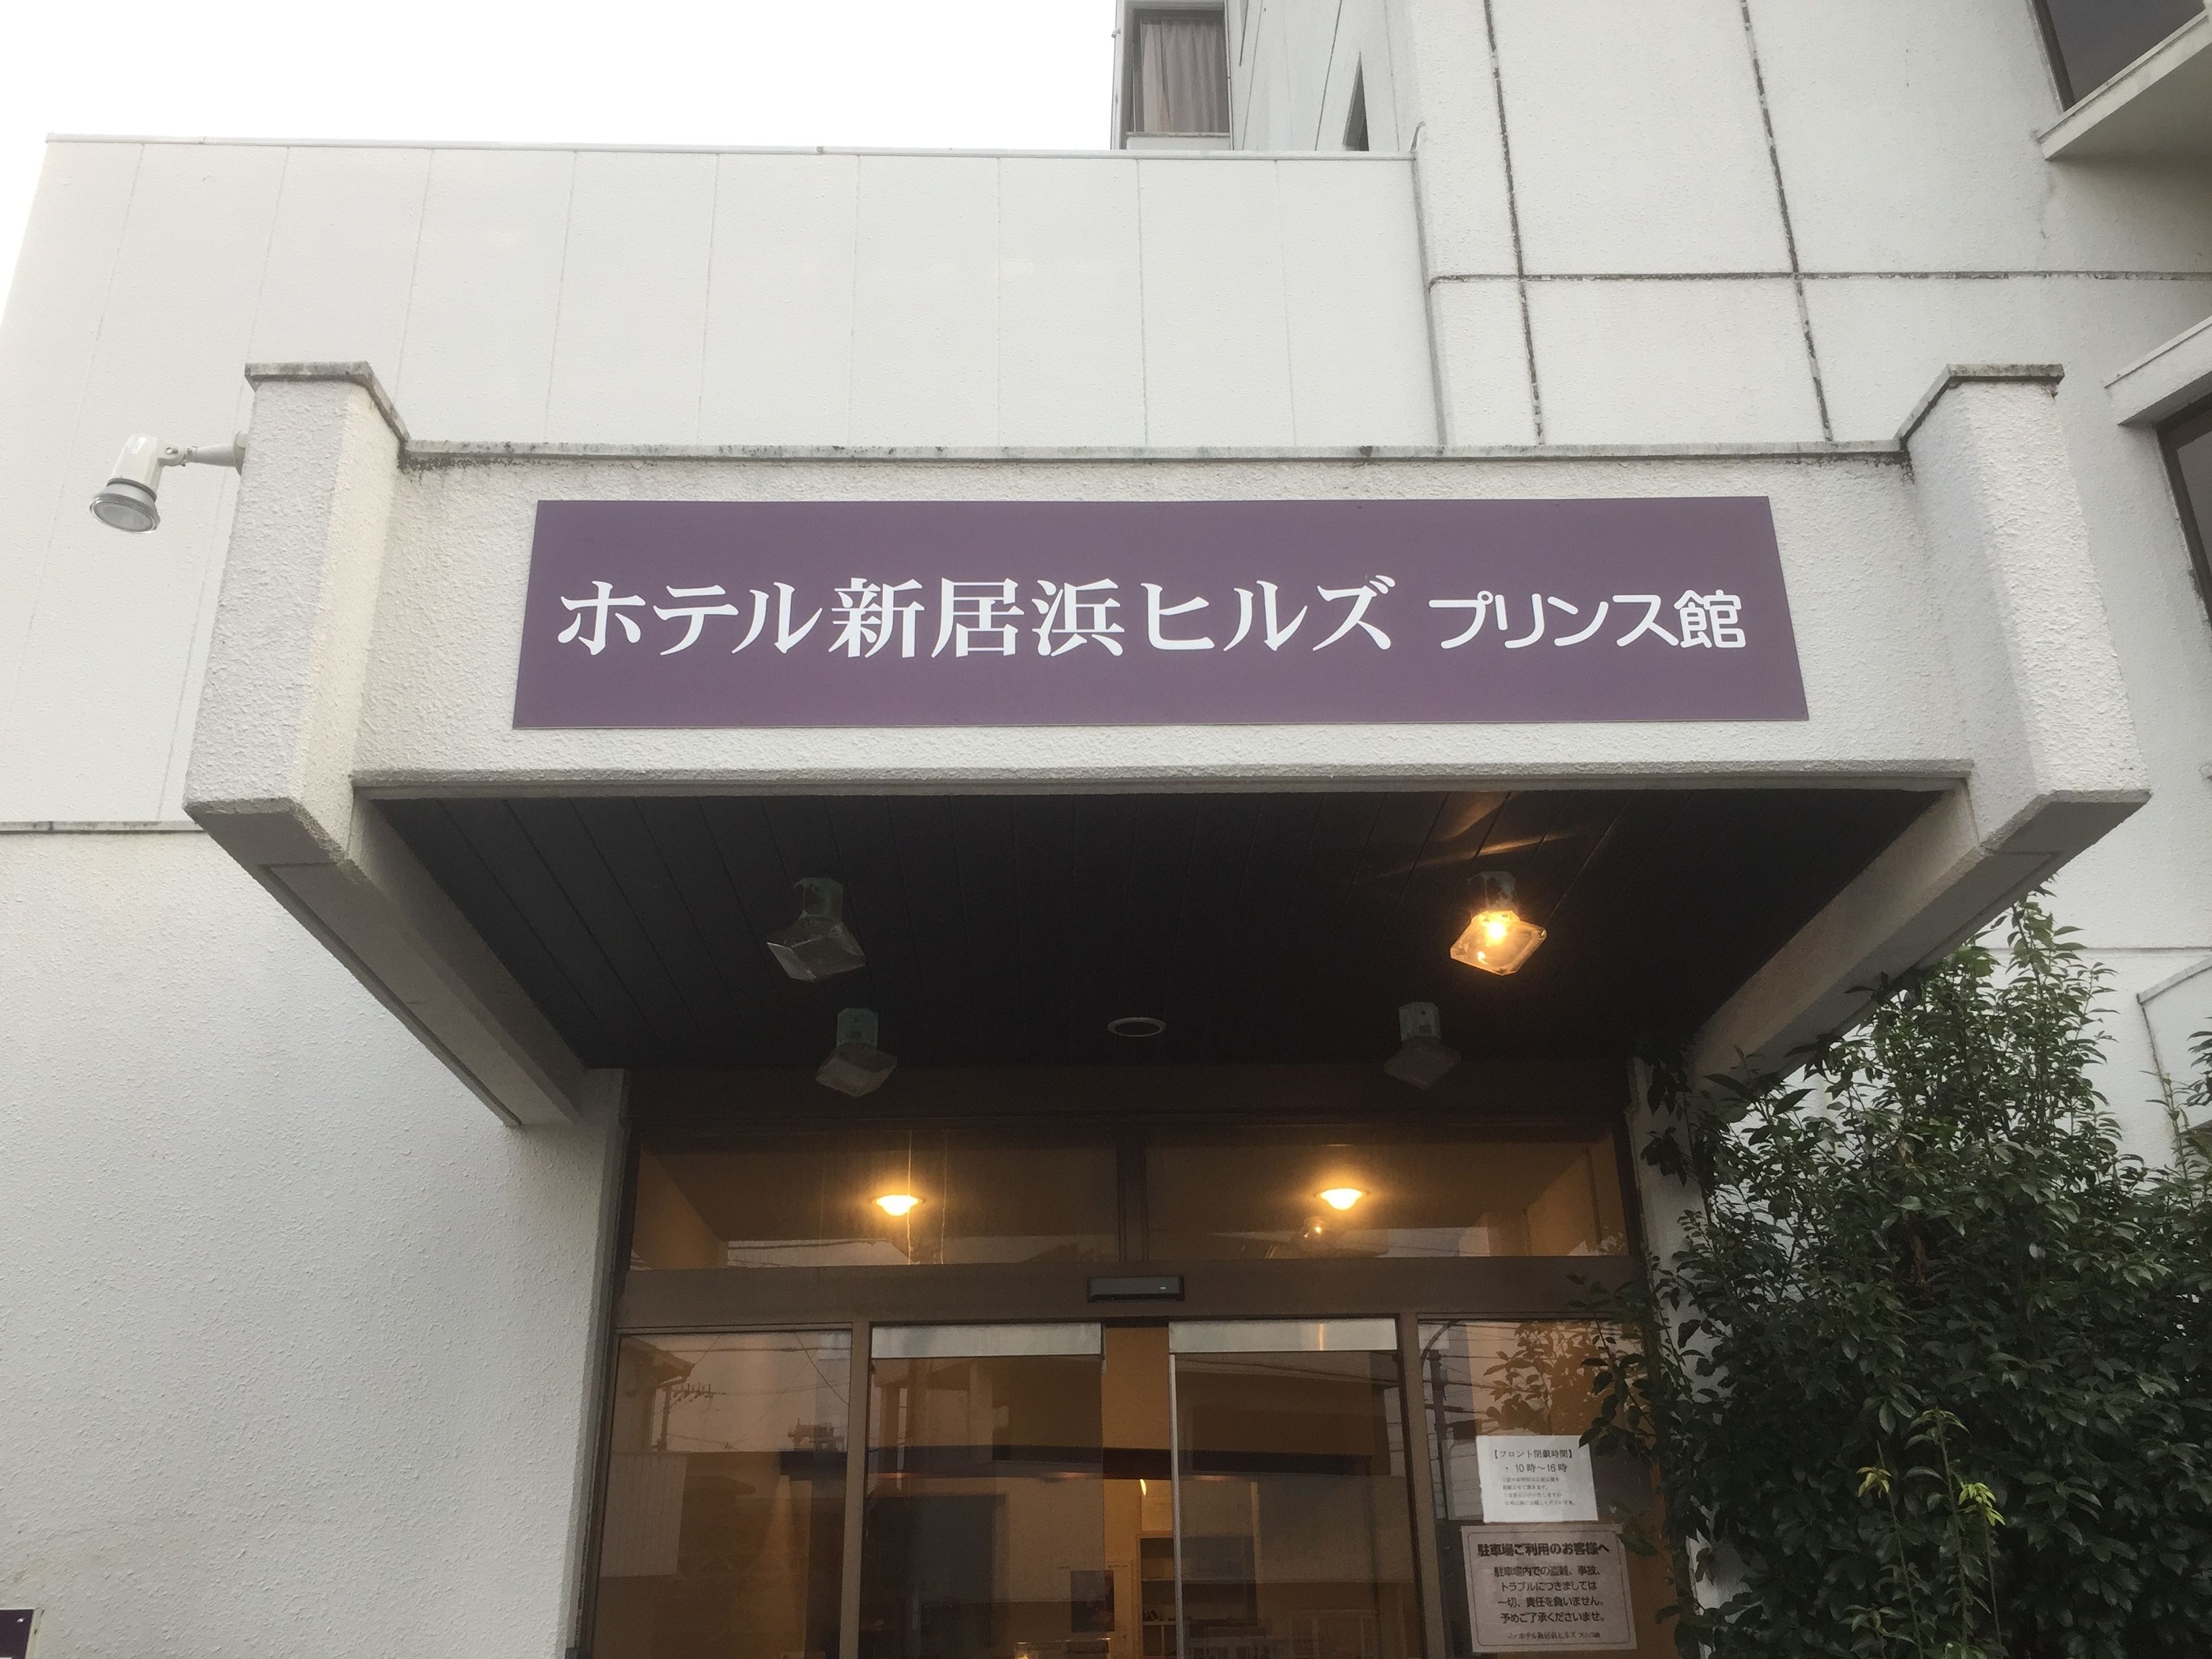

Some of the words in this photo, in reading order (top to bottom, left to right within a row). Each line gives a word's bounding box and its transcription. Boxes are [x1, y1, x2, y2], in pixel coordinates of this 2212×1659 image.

[558, 575, 1395, 657] ホテル新居浜ヒルズ
[1429, 589, 1746, 649] プリンス館
[1477, 1542, 1610, 1557] 駐車場ご利用のお客様へ
[1501, 1580, 1597, 1592] トラブルにつきましては
[1498, 1596, 1604, 1608] 一切、責任を負いません。
[1500, 1612, 1605, 1624] 予めご了承くださいませ。
